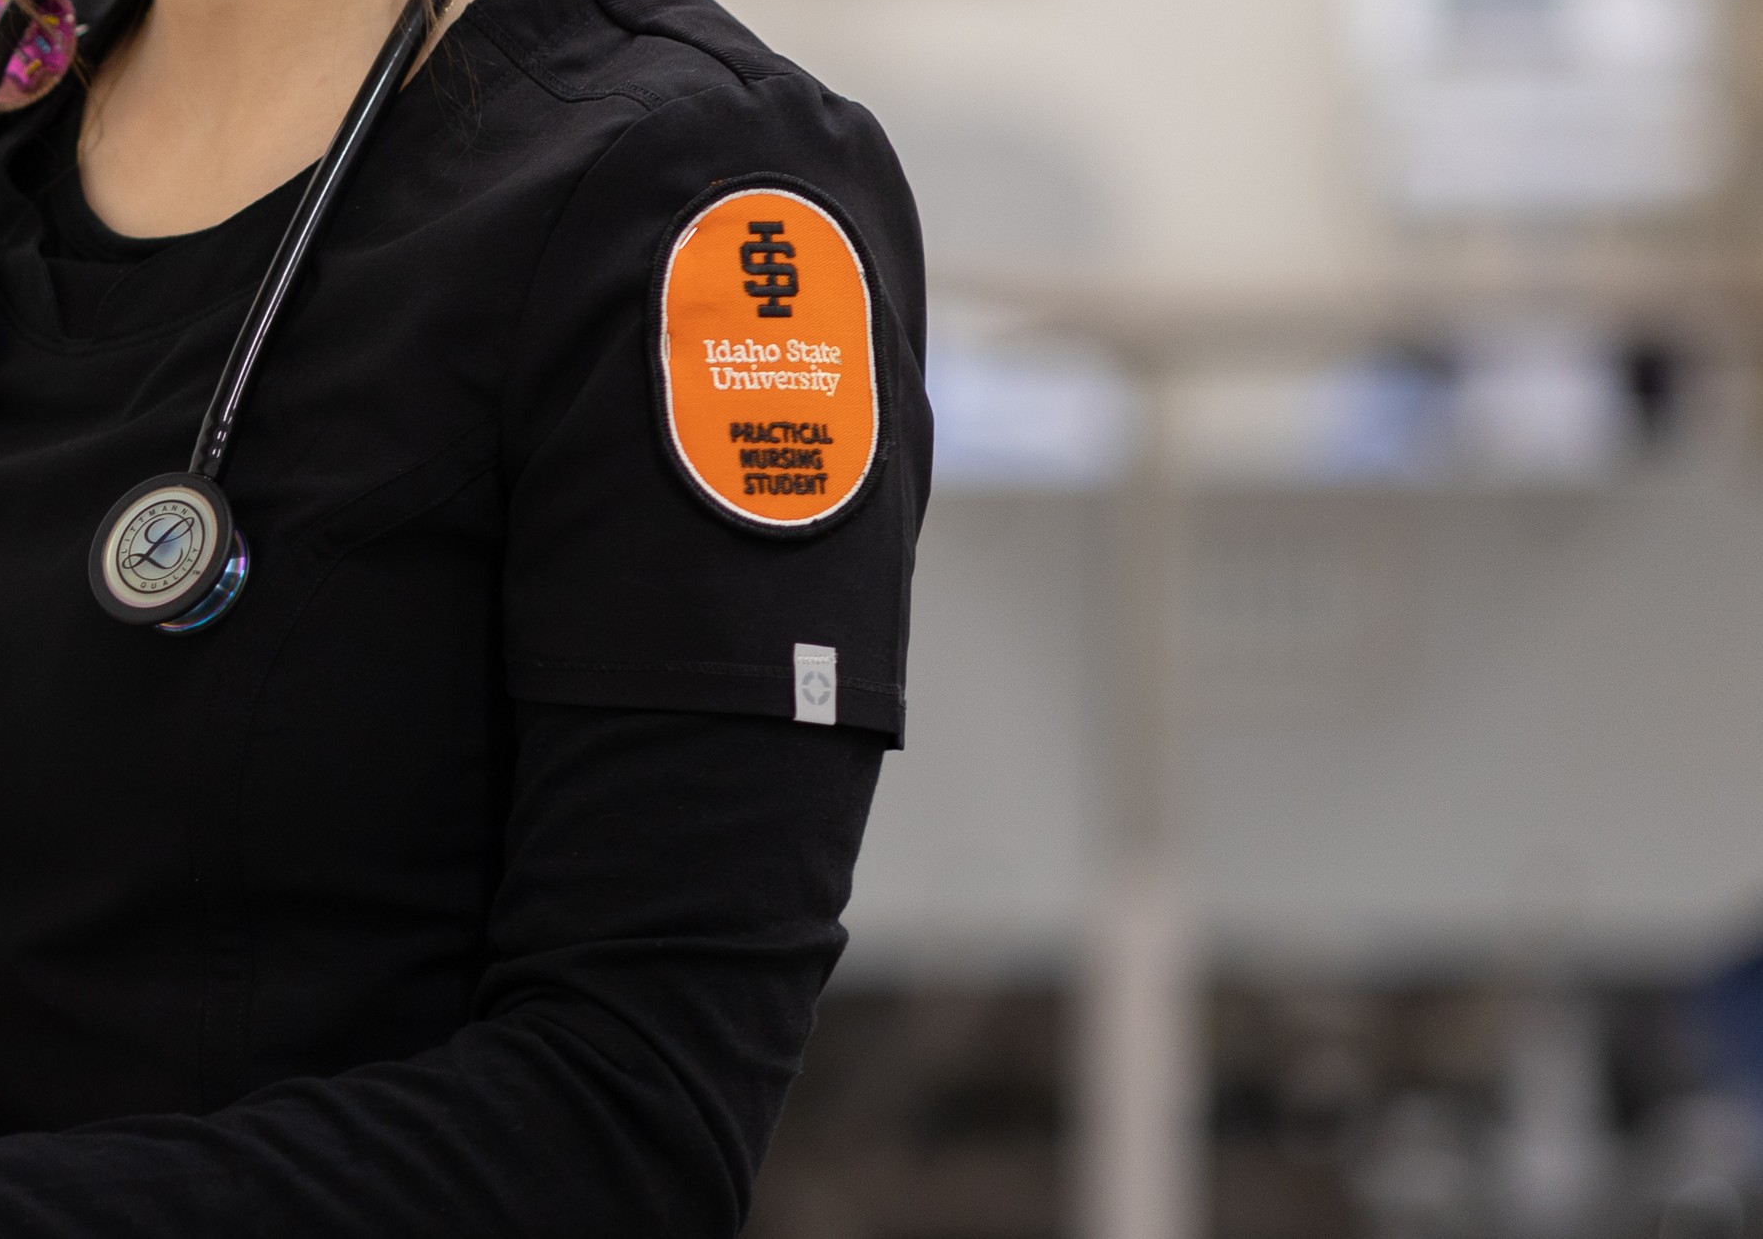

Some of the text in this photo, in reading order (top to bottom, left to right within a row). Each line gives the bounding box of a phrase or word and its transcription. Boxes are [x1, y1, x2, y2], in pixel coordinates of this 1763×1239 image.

[703, 339, 842, 364] Idaho State
[709, 364, 841, 397] University
[730, 421, 833, 444] PRACTICAL
[740, 448, 823, 469] NURSING
[744, 472, 828, 495] STUDENT
[121, 505, 189, 554] LITTMANN
[140, 547, 198, 590] QUALITY
